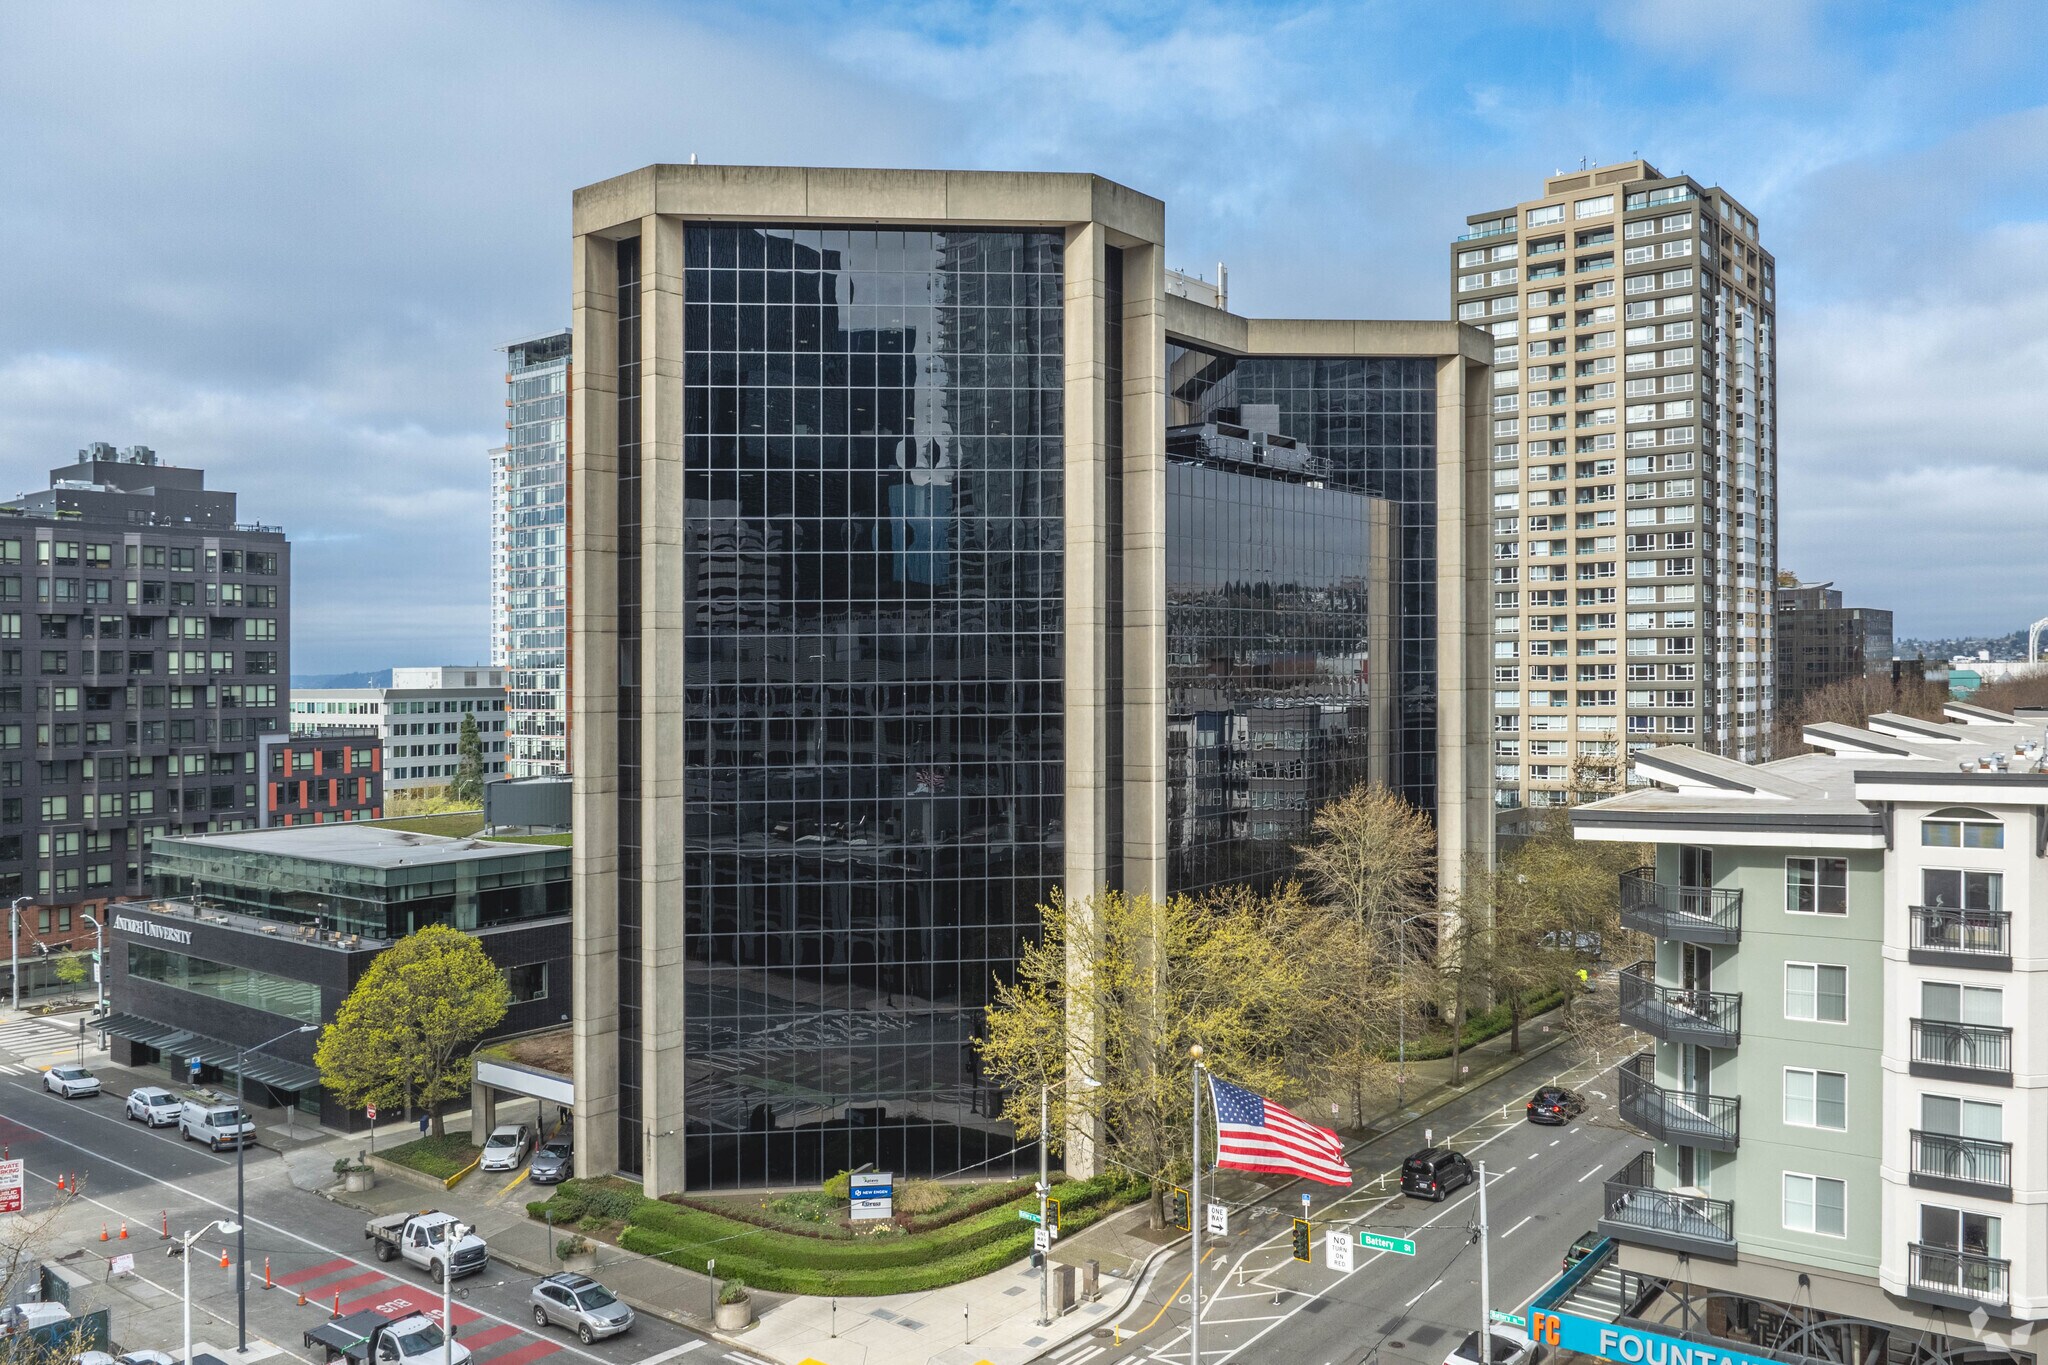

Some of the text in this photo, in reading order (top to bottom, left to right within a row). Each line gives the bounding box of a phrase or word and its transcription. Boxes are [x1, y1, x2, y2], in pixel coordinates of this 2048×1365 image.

[144, 920, 192, 944] UNIVERSITY
[1211, 1207, 1223, 1215] ONE
[1211, 1215, 1223, 1223] WAY
[1333, 1236, 1345, 1245] NO
[1365, 1235, 1411, 1252] Battery St
[1332, 1245, 1347, 1253] TURN
[375, 1298, 413, 1313] BUS
[1533, 1312, 1561, 1346] FC
[1600, 1329, 1749, 1365] FOUNT
